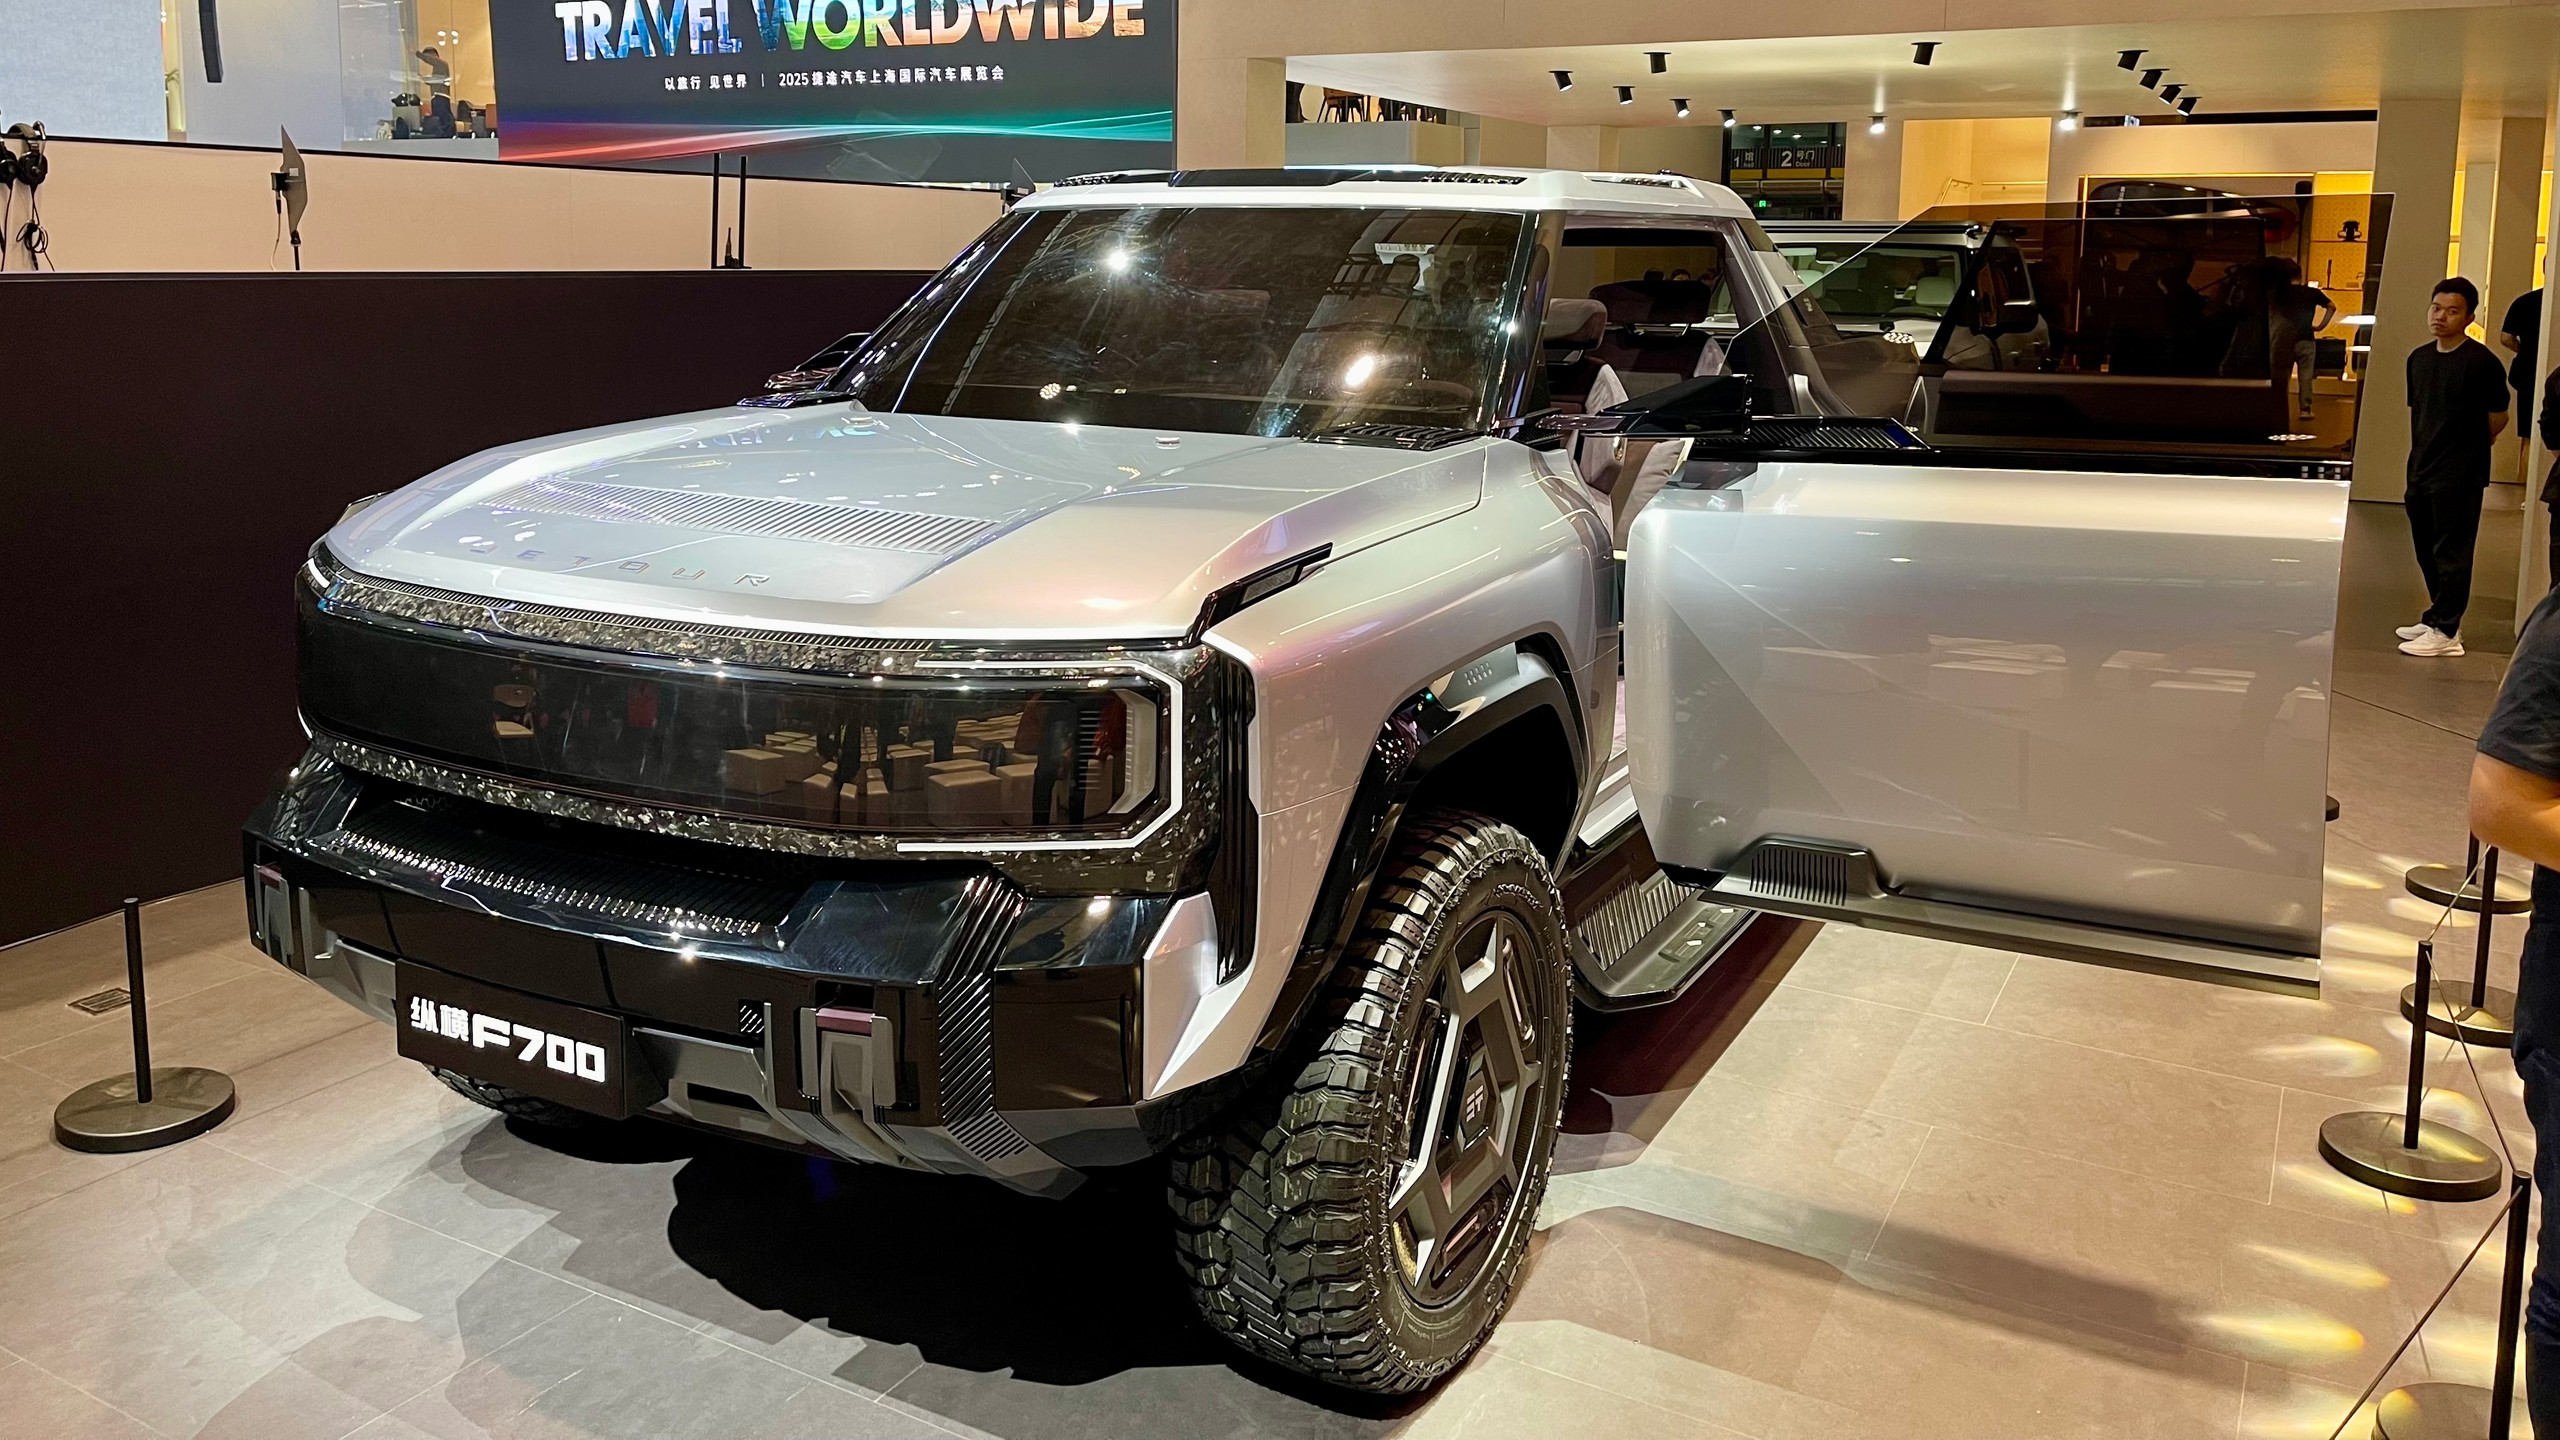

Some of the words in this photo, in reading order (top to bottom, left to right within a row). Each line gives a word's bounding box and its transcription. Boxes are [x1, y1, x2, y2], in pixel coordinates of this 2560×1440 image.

[555, 0, 742, 61] TRAVEL
[752, 0, 1145, 51] WORLDWIDE
[664, 75, 701, 91] 以旅行
[709, 73, 747, 90] 见世界
[1781, 150, 1793, 167] 2
